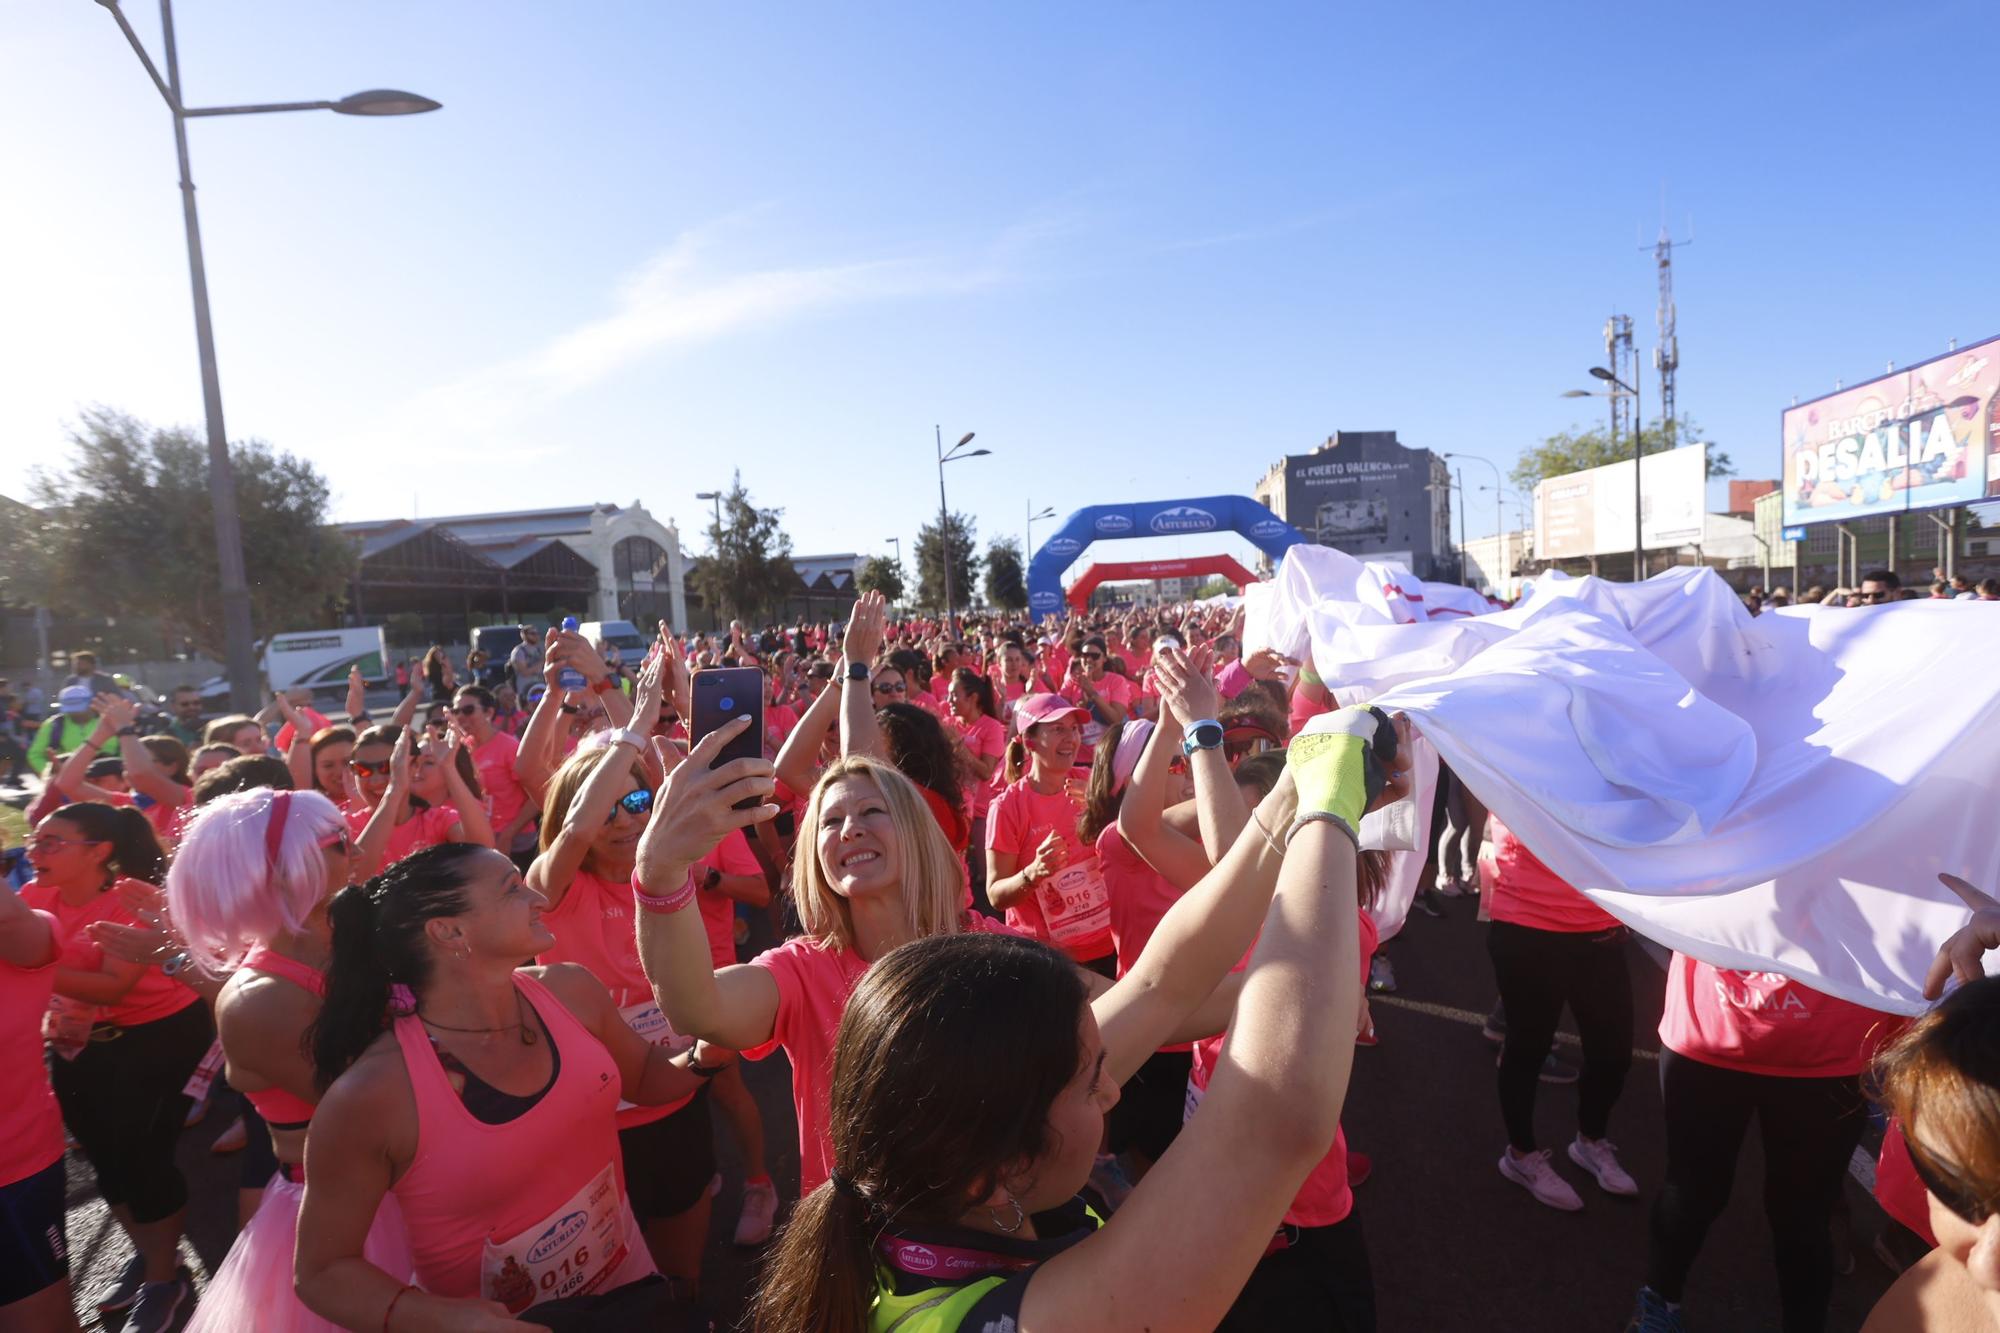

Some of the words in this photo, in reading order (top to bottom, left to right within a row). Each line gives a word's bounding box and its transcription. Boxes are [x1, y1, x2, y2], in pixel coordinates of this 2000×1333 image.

[1796, 413, 1959, 487] DESALIA
[1308, 464, 1344, 476] PUERTO
[1156, 518, 1212, 529] ASTURIANA
[1066, 890, 1090, 906] 016
[1715, 982, 1806, 1011] SUMA
[533, 1218, 586, 1261] ASTURIANA
[540, 1246, 590, 1291] 016
[553, 1272, 585, 1299] 1466
